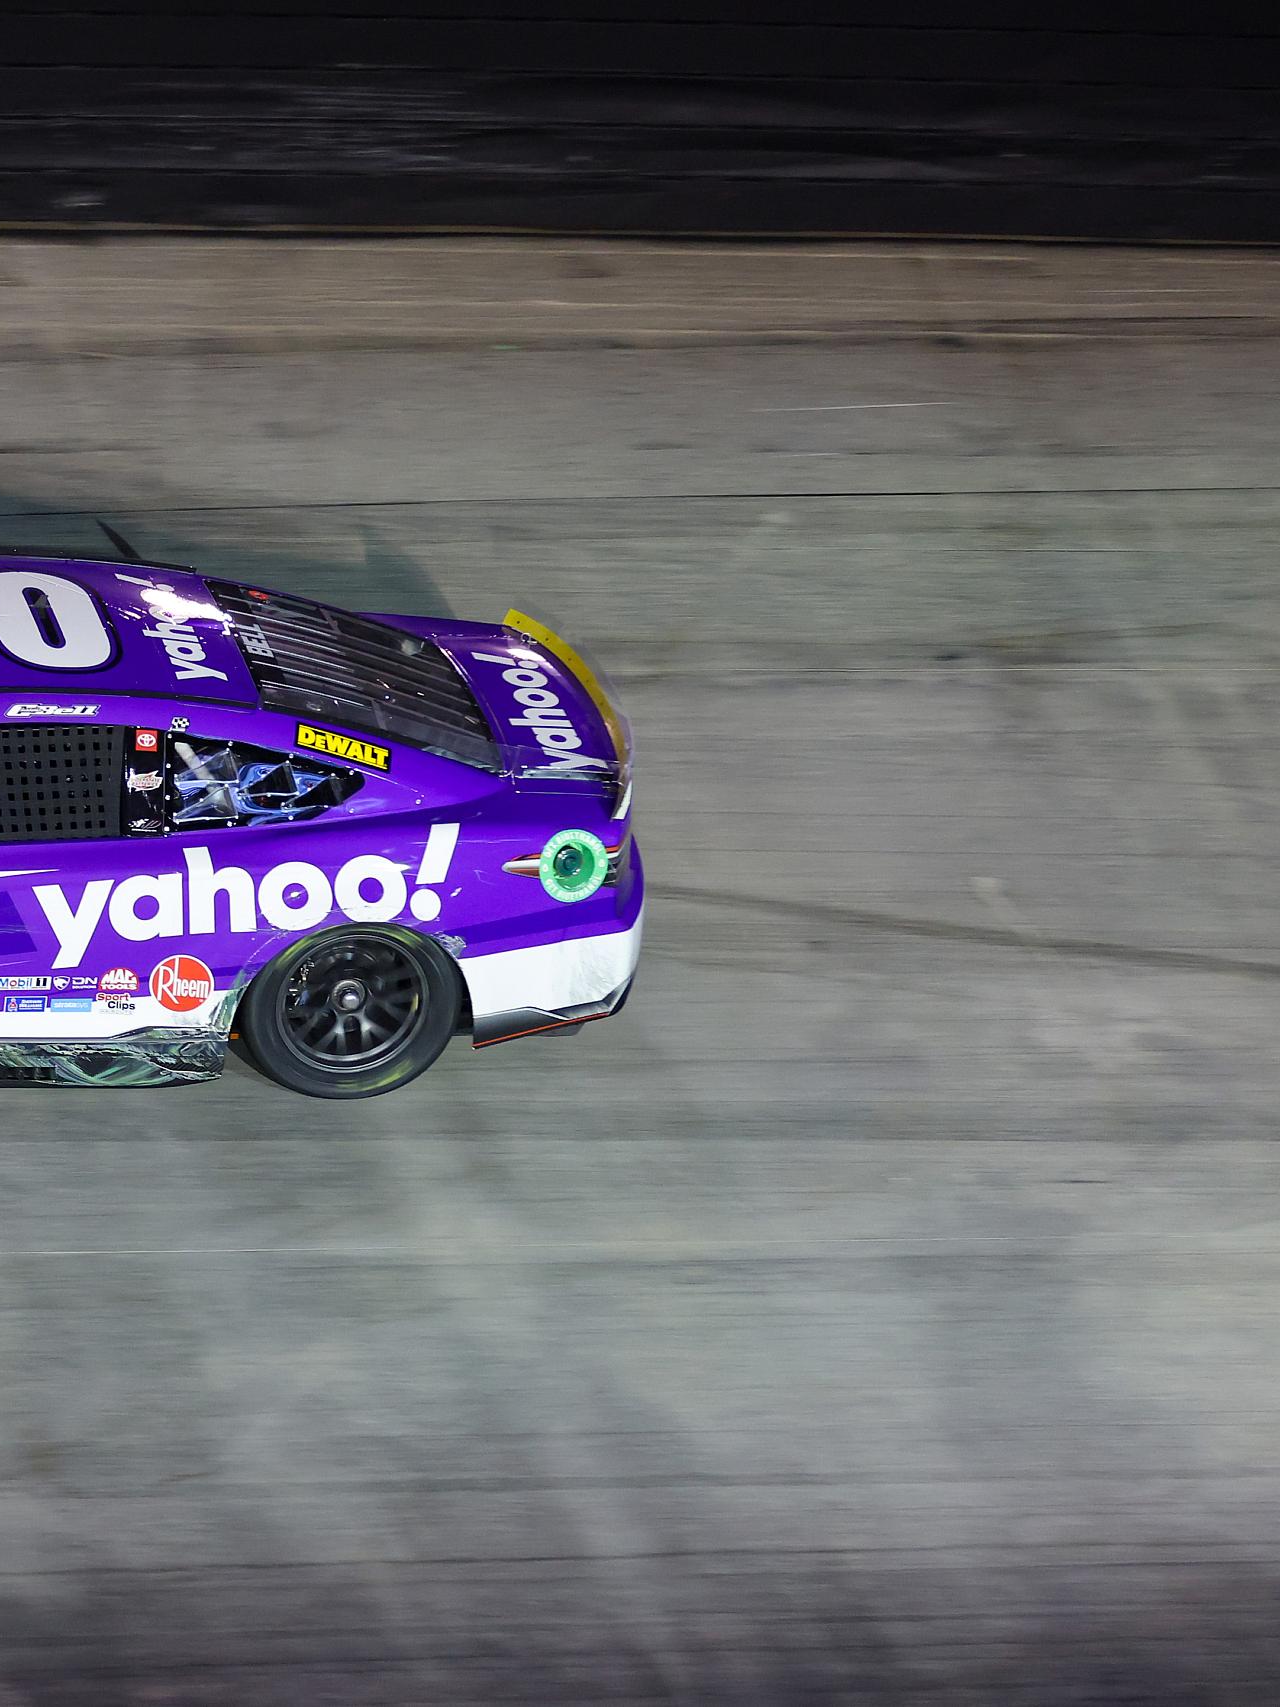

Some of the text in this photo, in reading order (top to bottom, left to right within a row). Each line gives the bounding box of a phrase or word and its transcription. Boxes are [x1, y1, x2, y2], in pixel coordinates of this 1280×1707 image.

[235, 623, 274, 658] BELL
[471, 652, 608, 770] yahoo!
[31, 823, 460, 969] yahoo!
[36, 977, 47, 987] 1
[72, 976, 98, 984] DN
[101, 968, 137, 984] MAC
[157, 957, 209, 1005] Rheem
[97, 993, 129, 1001] Sport
[108, 1001, 136, 1010] Clips
